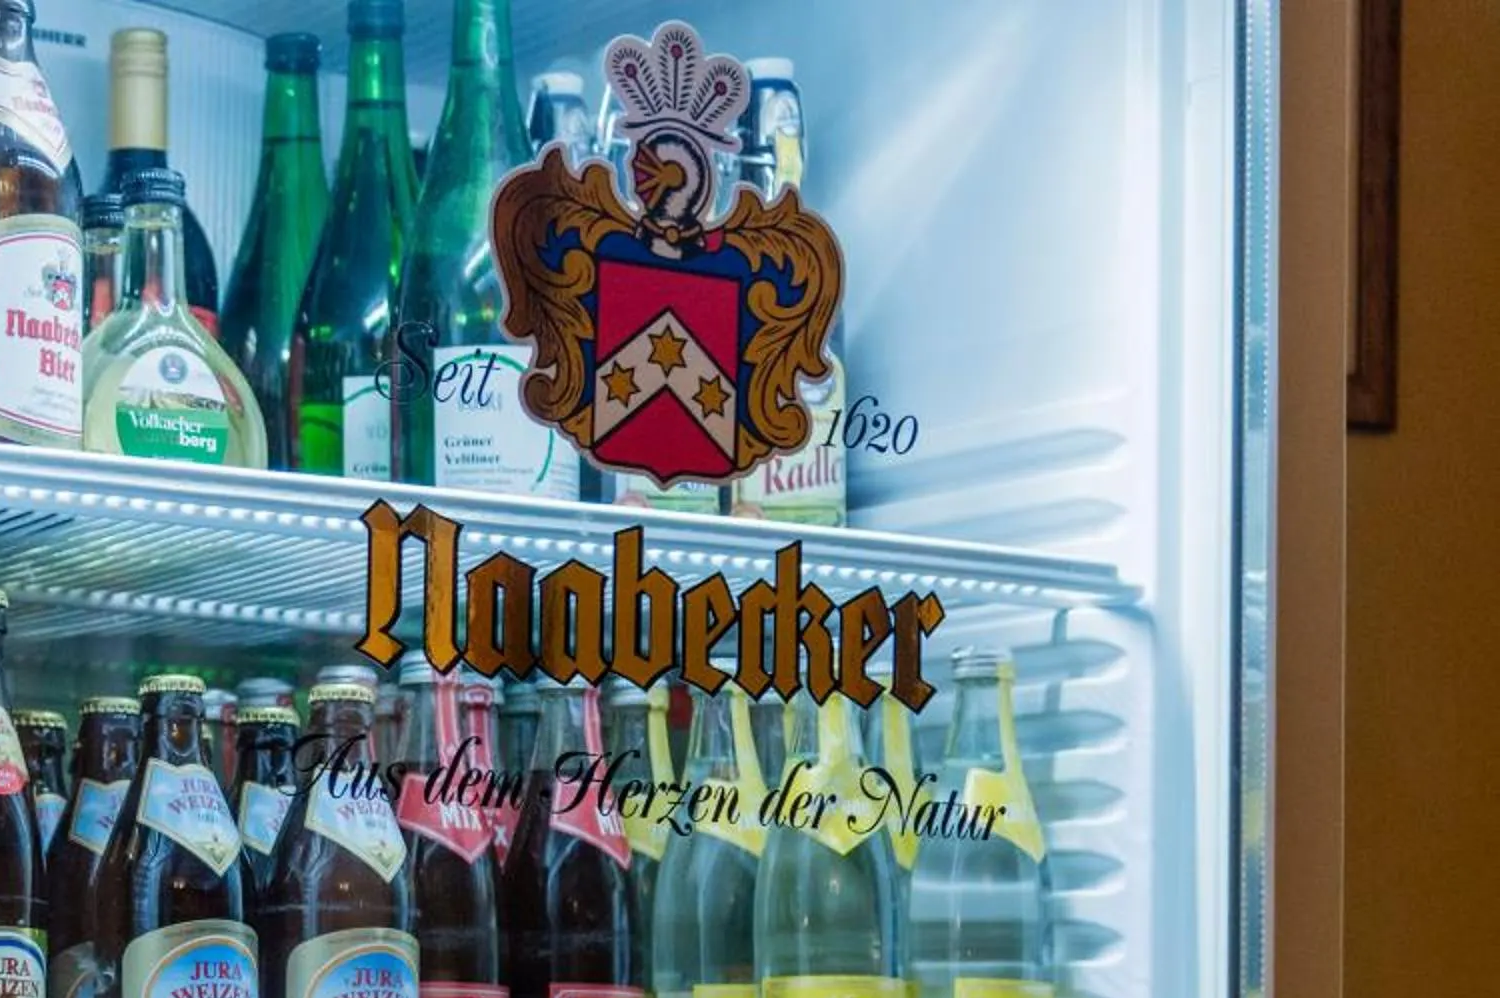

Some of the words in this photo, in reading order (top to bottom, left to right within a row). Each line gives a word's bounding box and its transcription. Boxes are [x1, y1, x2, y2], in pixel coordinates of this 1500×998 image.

[39, 346, 76, 384] Bier
[374, 319, 502, 407] Seit
[820, 395, 919, 455] 1620
[128, 409, 202, 434] Volkacher
[443, 435, 493, 448] Grüner
[353, 498, 946, 715] Naabecker
[276, 732, 409, 804] Aus
[422, 734, 524, 810] dem
[539, 748, 741, 837] Herzen
[758, 760, 837, 830] der
[846, 766, 1006, 841] Natur
[189, 959, 244, 982] JURA
[351, 966, 406, 989] JURA
